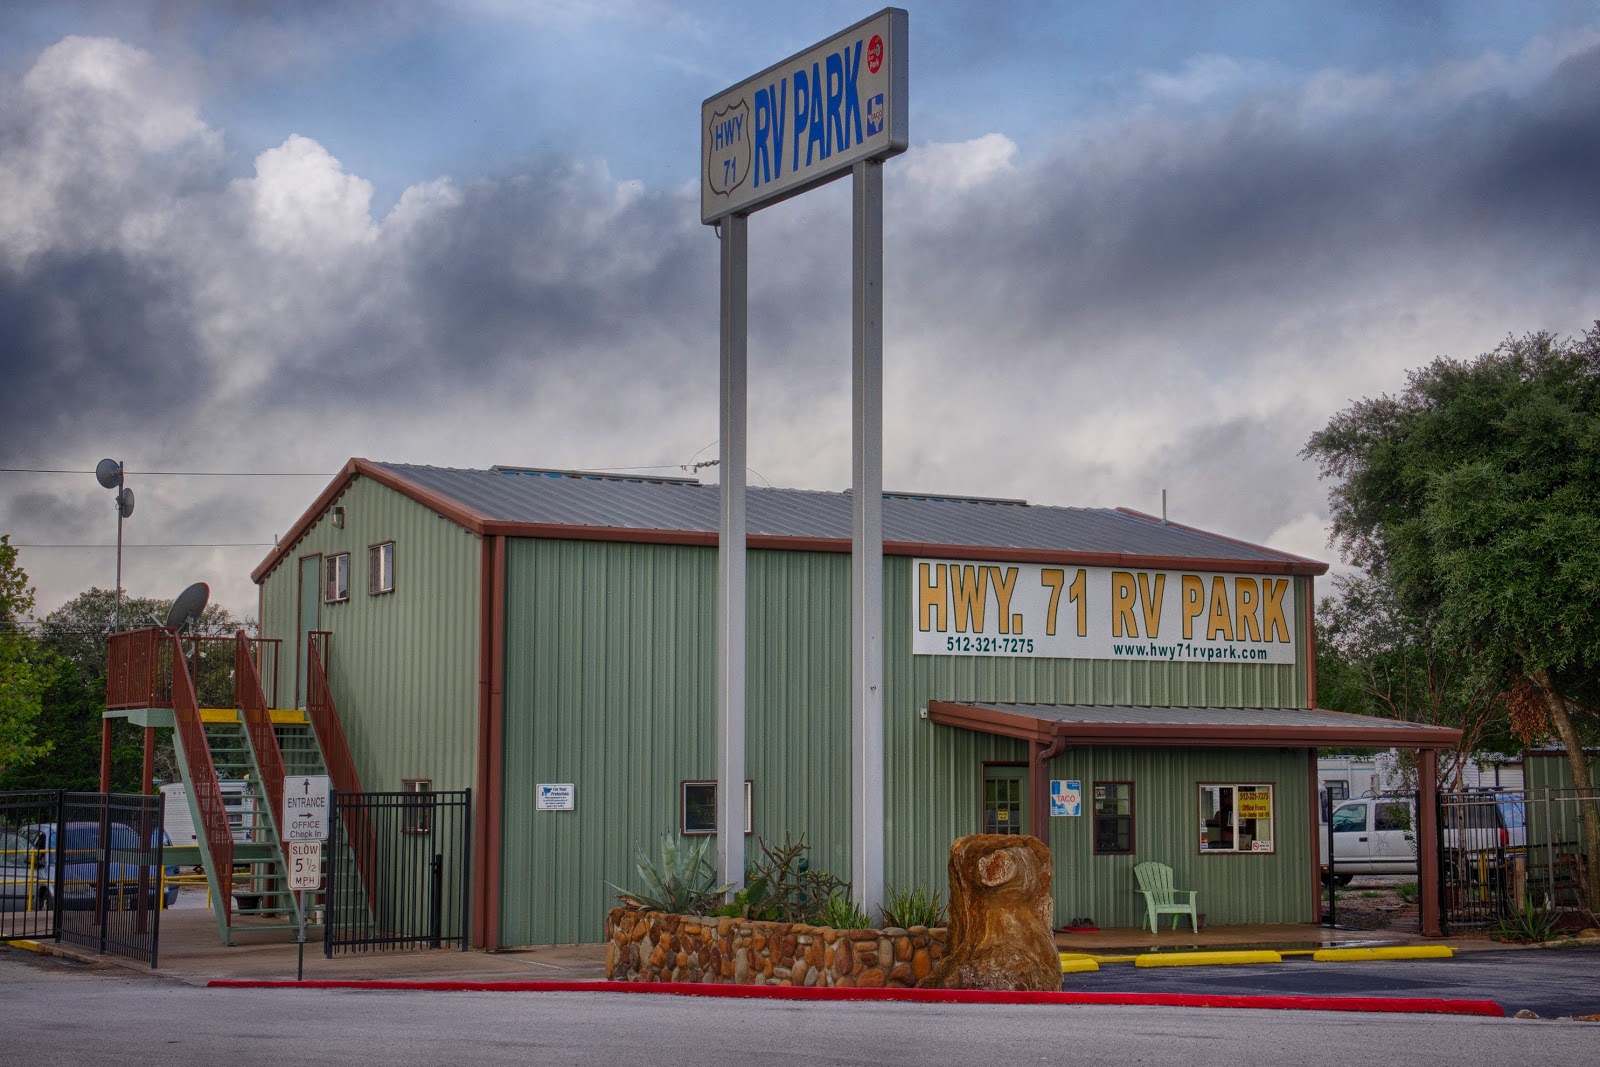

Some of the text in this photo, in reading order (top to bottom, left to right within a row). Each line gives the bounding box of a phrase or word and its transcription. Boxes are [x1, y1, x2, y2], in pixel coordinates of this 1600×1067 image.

[870, 59, 879, 69] Park
[753, 39, 864, 188] RV PARK
[871, 109, 883, 120] TACO
[715, 113, 744, 151] HWY
[723, 156, 737, 187] 71
[918, 562, 1291, 644] HWY. 71 RV PARK
[946, 636, 1034, 654] 512-321-7275
[1113, 642, 1268, 662] www.hwy71rvpark.com
[287, 797, 325, 808] ENTRANCE
[1056, 795, 1076, 803] TACO
[291, 820, 320, 829] OFFICE
[290, 830, 313, 838] Check
[292, 845, 318, 855] SLOW
[295, 876, 315, 885] MPH
